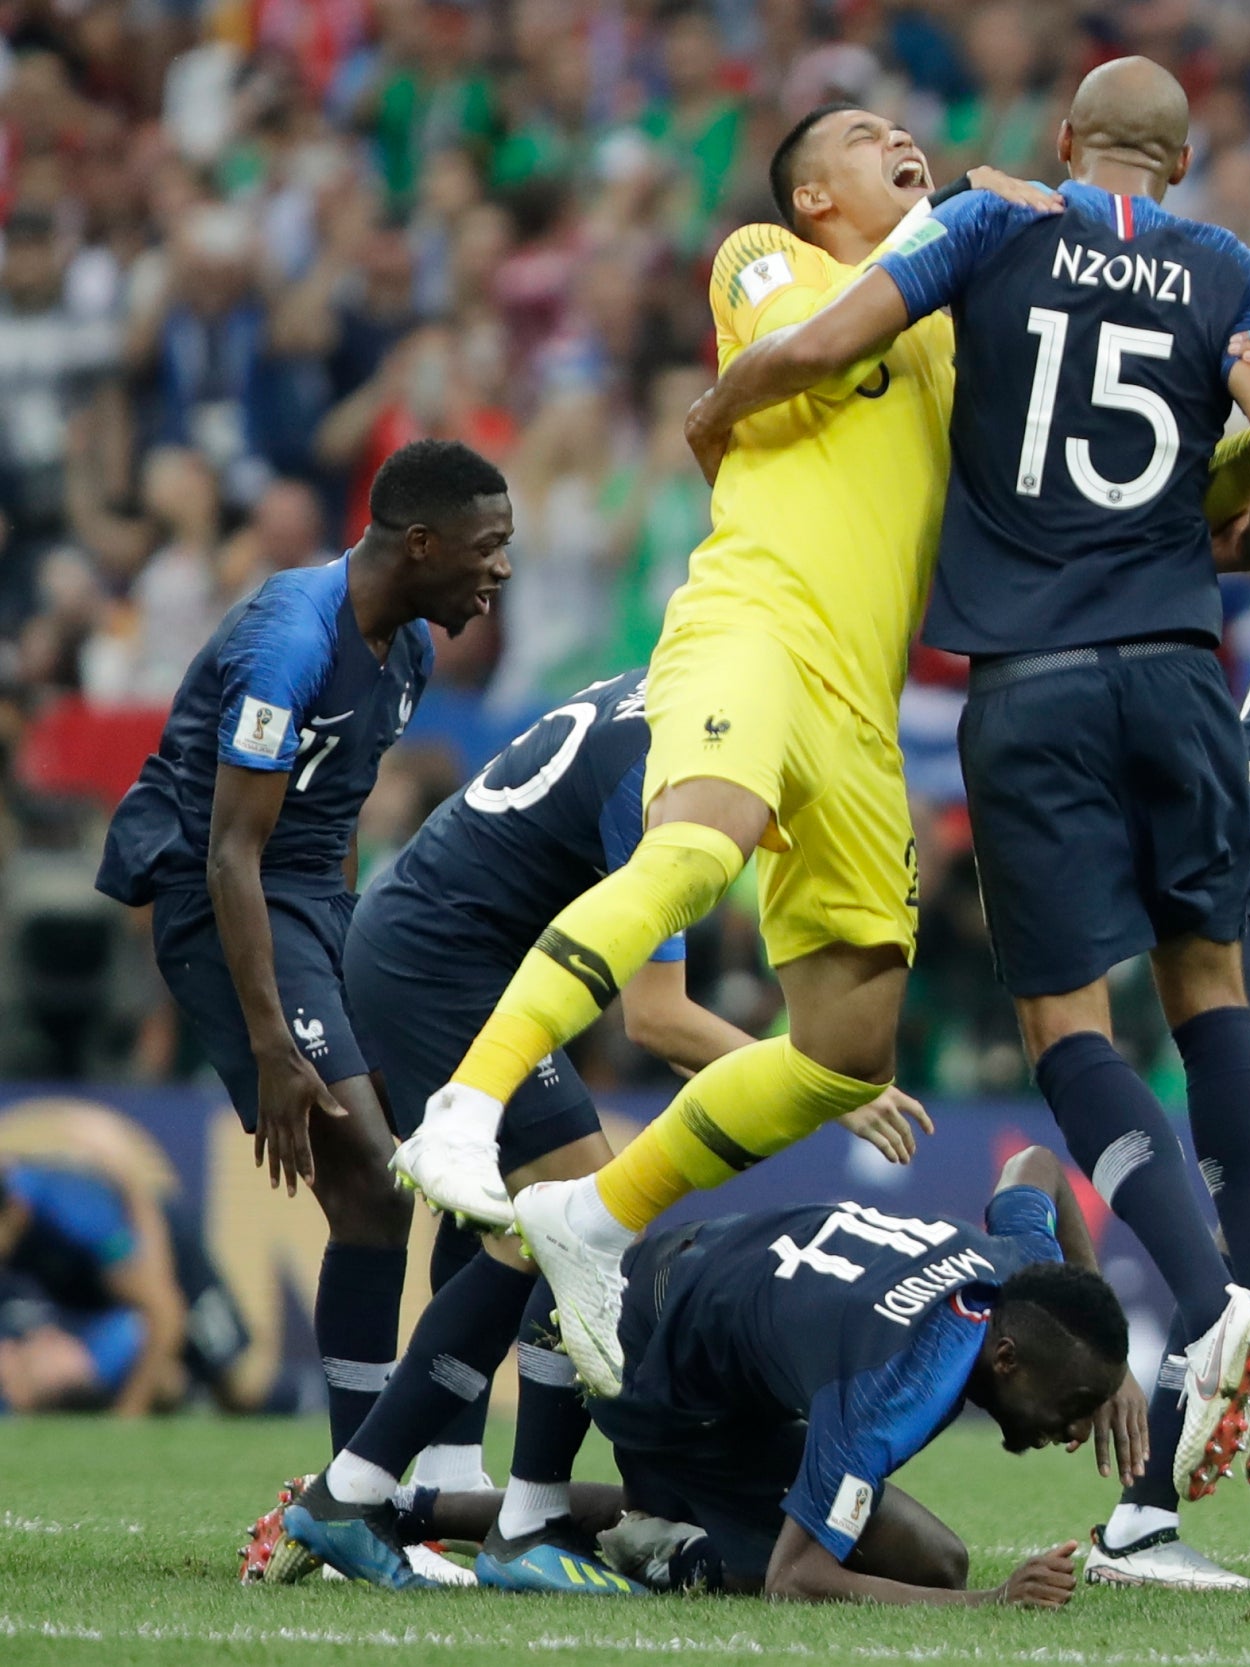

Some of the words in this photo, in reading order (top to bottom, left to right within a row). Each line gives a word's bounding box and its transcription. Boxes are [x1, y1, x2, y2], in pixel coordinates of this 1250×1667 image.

[1052, 238, 1191, 305] NZONZI
[1016, 306, 1180, 510] 15
[768, 1201, 958, 1282] 14
[873, 1248, 995, 1326] MATUIDI
